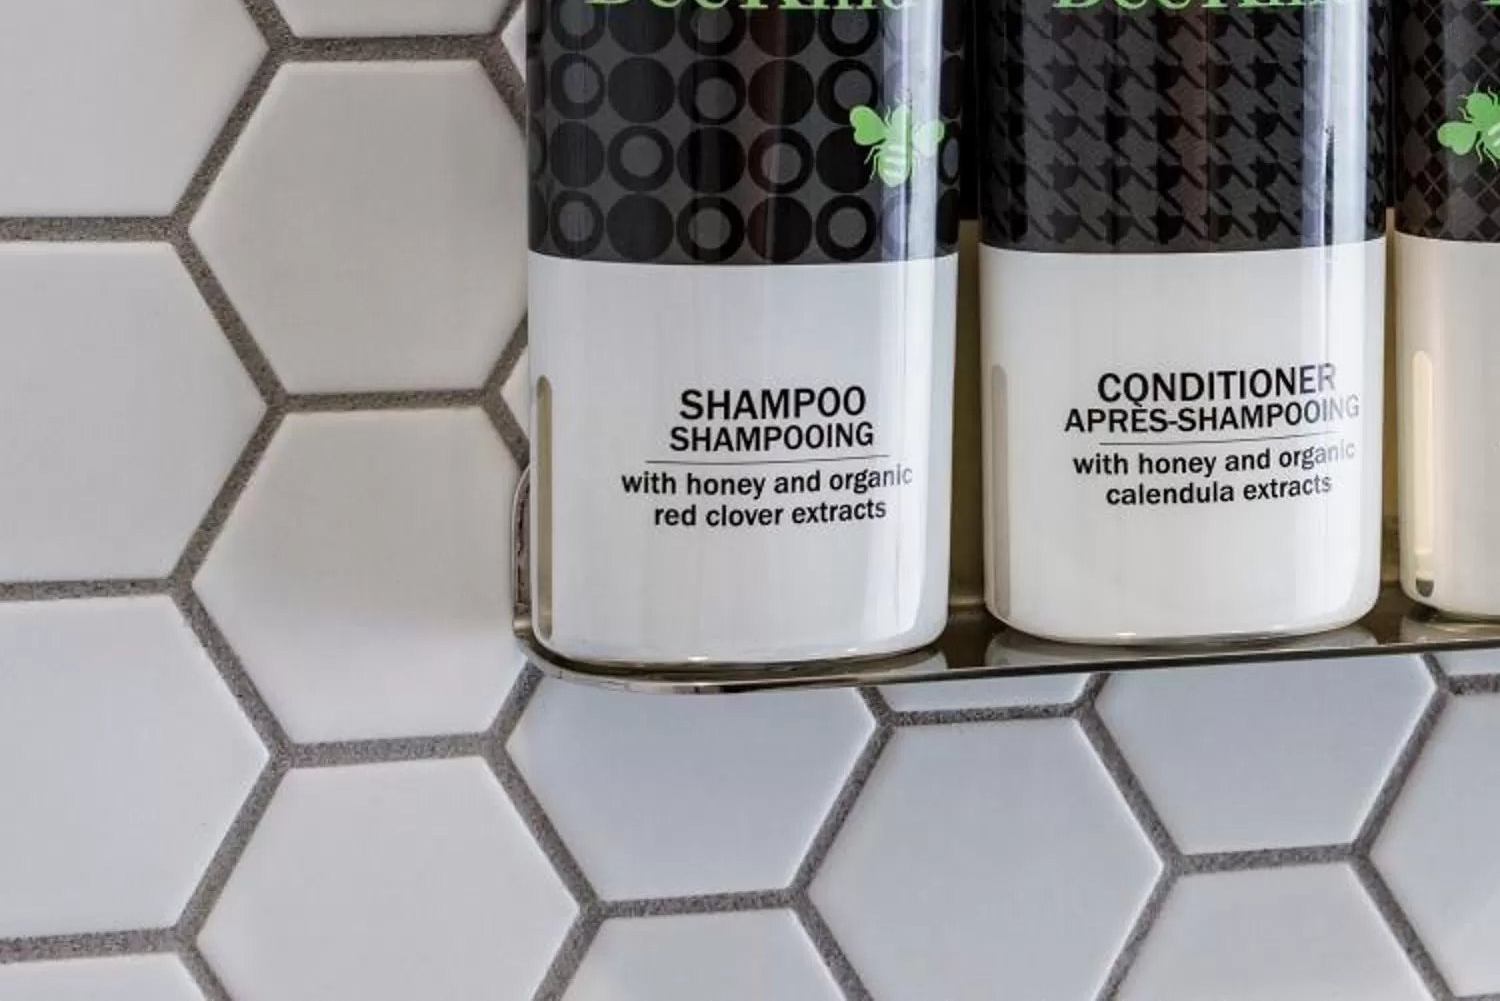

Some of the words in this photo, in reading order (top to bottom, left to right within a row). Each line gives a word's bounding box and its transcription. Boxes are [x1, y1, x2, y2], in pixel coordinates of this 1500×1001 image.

[1097, 362, 1336, 403] CONDITIONER
[679, 385, 867, 420] SHAMPOO
[1064, 394, 1360, 433] APRÈS-SHAMPOOING
[669, 420, 875, 452] SHAMPOOING
[1073, 452, 1129, 475] with
[1138, 453, 1217, 477] honey
[1224, 447, 1271, 472] and
[1278, 439, 1356, 470] organic
[621, 470, 677, 495] with
[686, 472, 766, 500] honey
[773, 470, 821, 493] and
[828, 463, 913, 493] organic
[1106, 480, 1235, 506] calendula
[1242, 473, 1333, 501] extracts
[654, 503, 697, 527] red
[705, 503, 785, 527] clover
[791, 498, 887, 524] extracts
